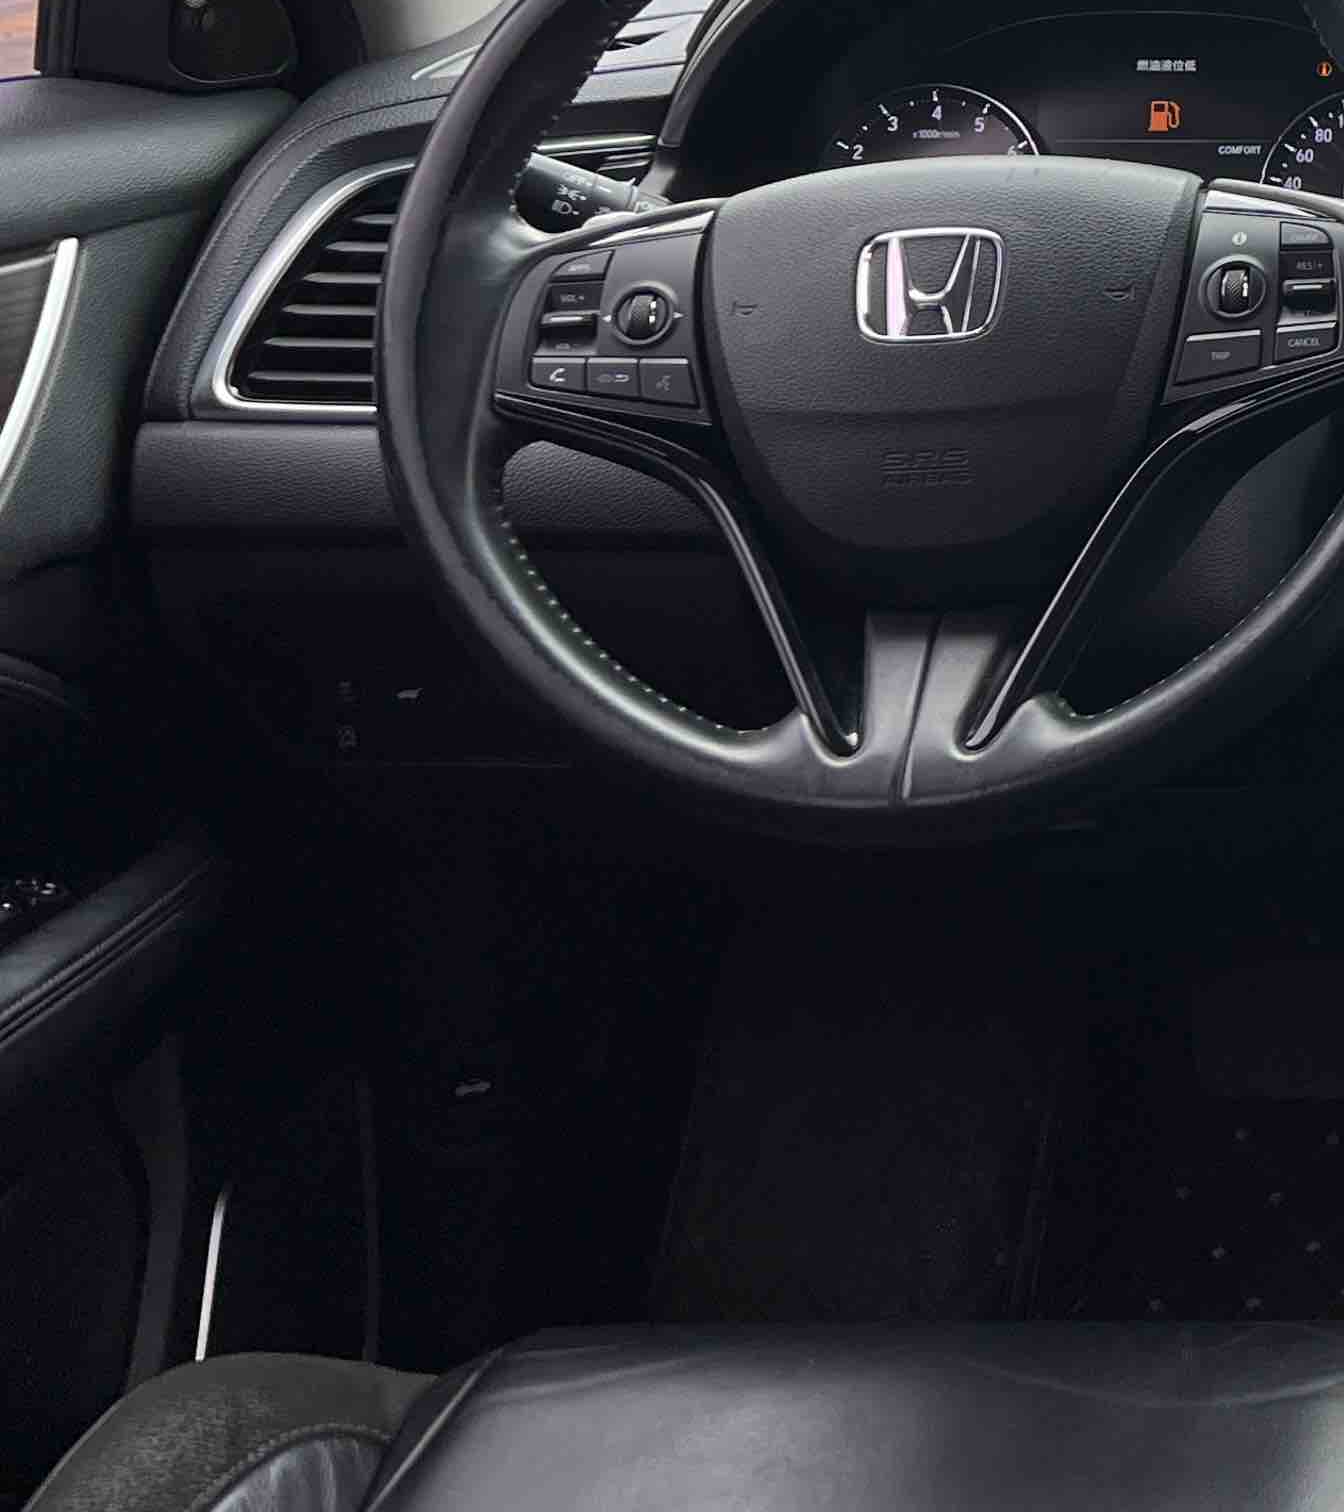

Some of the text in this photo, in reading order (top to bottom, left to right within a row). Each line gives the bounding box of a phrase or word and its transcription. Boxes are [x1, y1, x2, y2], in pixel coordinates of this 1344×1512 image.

[931, 105, 943, 120] 4
[887, 116, 899, 131] 3
[973, 117, 985, 132] 5
[1314, 128, 1333, 143] 80
[852, 143, 864, 160] 2
[1218, 144, 1262, 155] COMFORT
[1295, 148, 1314, 163] 60
[1283, 175, 1302, 190] 40
[1287, 338, 1321, 348] CANCEL
